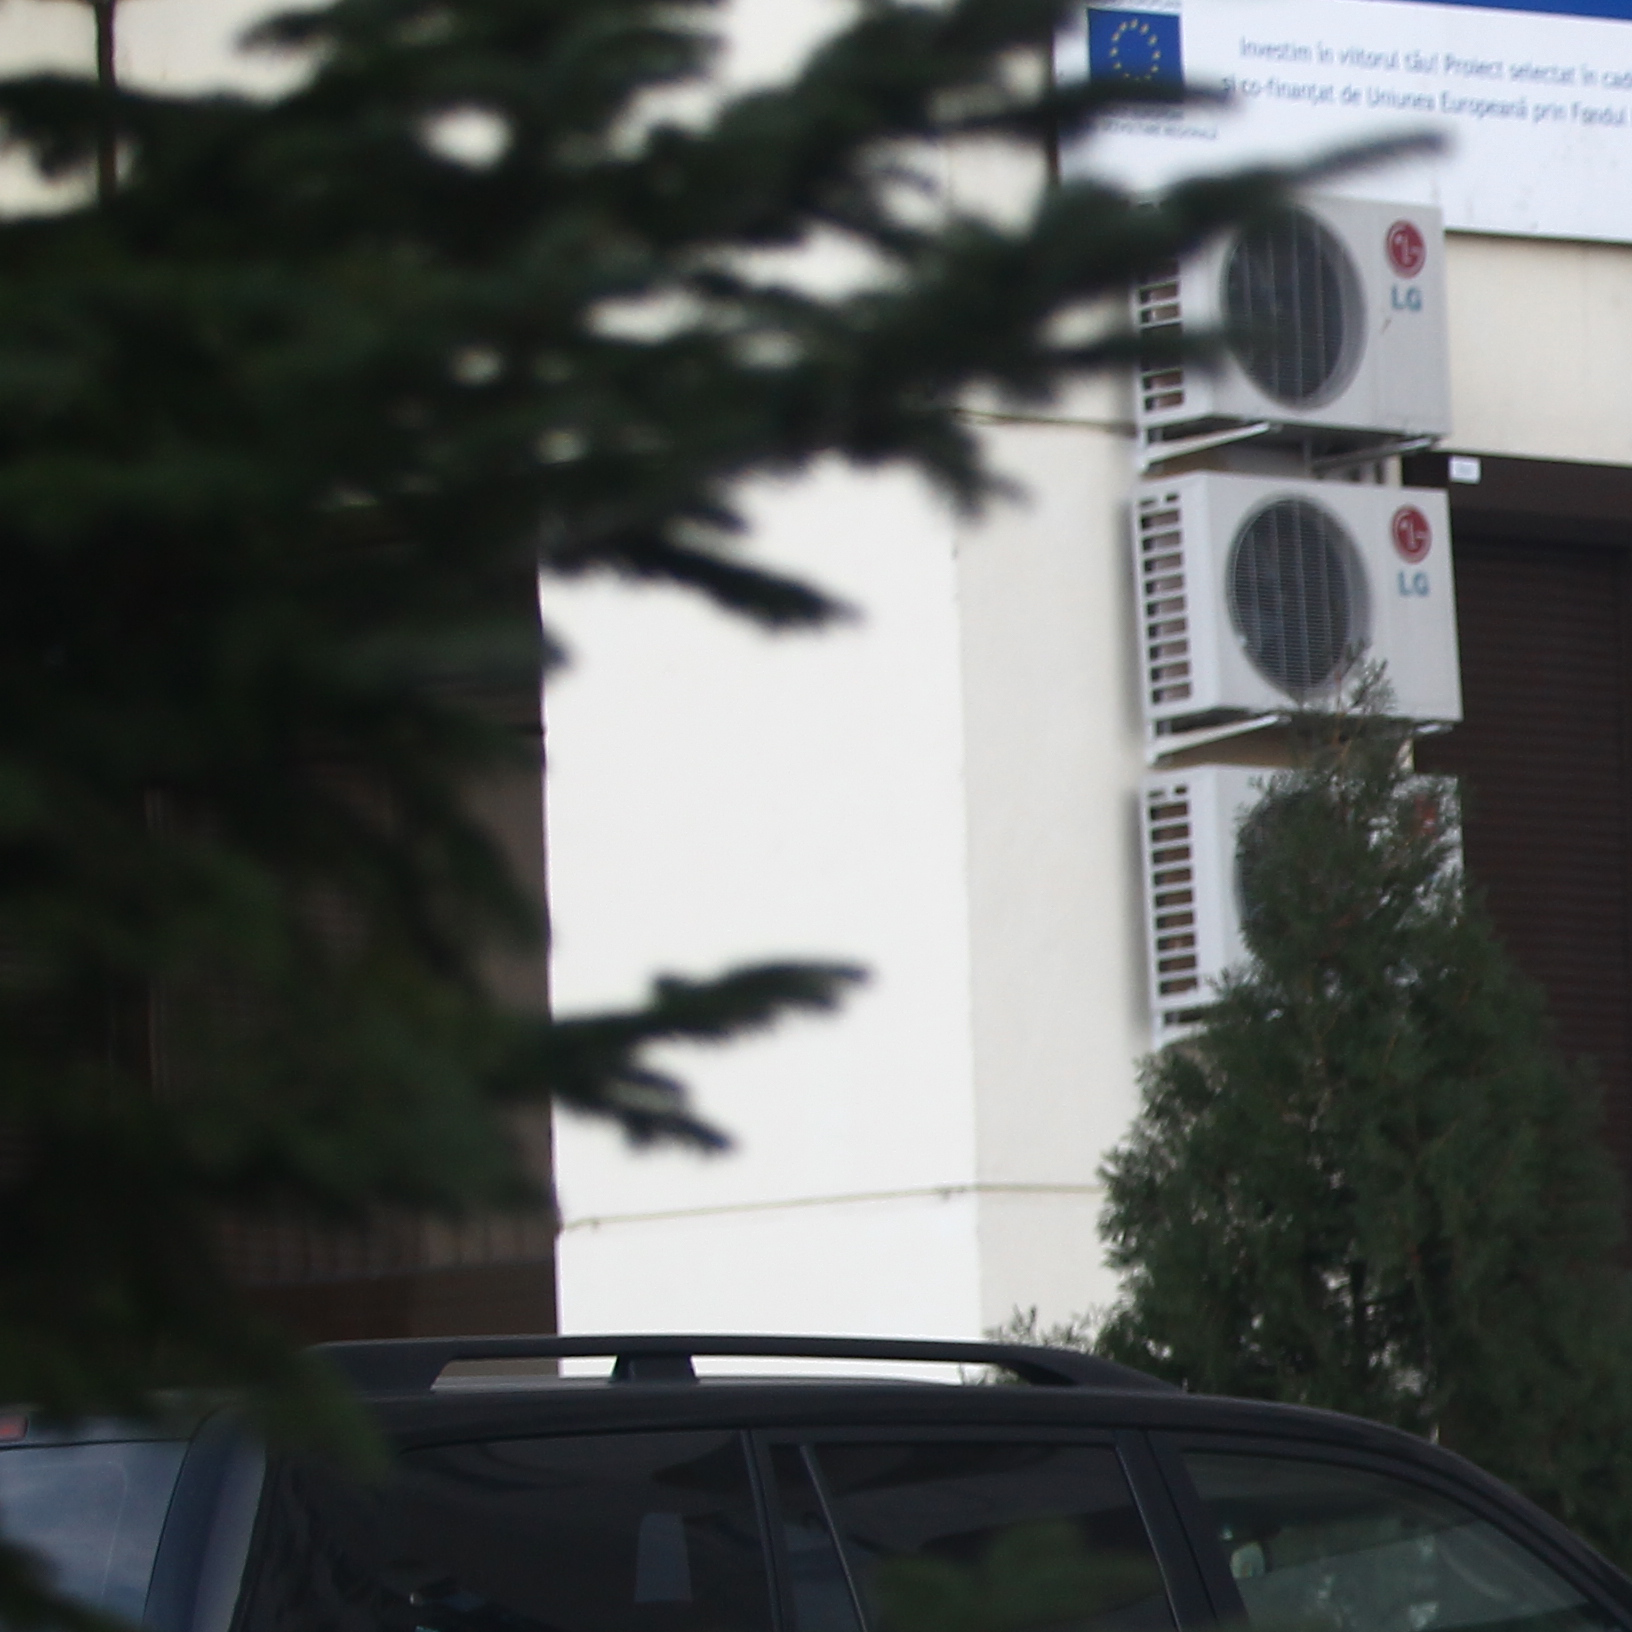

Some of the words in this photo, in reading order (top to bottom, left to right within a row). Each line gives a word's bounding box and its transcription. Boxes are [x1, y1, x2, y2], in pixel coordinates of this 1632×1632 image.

[1240, 34, 1312, 61] Investim
[1339, 47, 1400, 70] viitorul
[1444, 53, 1503, 79] Proiect
[1509, 61, 1576, 84] selectat
[1341, 83, 1361, 104] de
[1366, 86, 1436, 108] Uniunea
[1532, 102, 1567, 123] prin
[1570, 101, 1625, 126] Fondul
[1391, 283, 1422, 312] LG
[1398, 570, 1430, 597] LG
